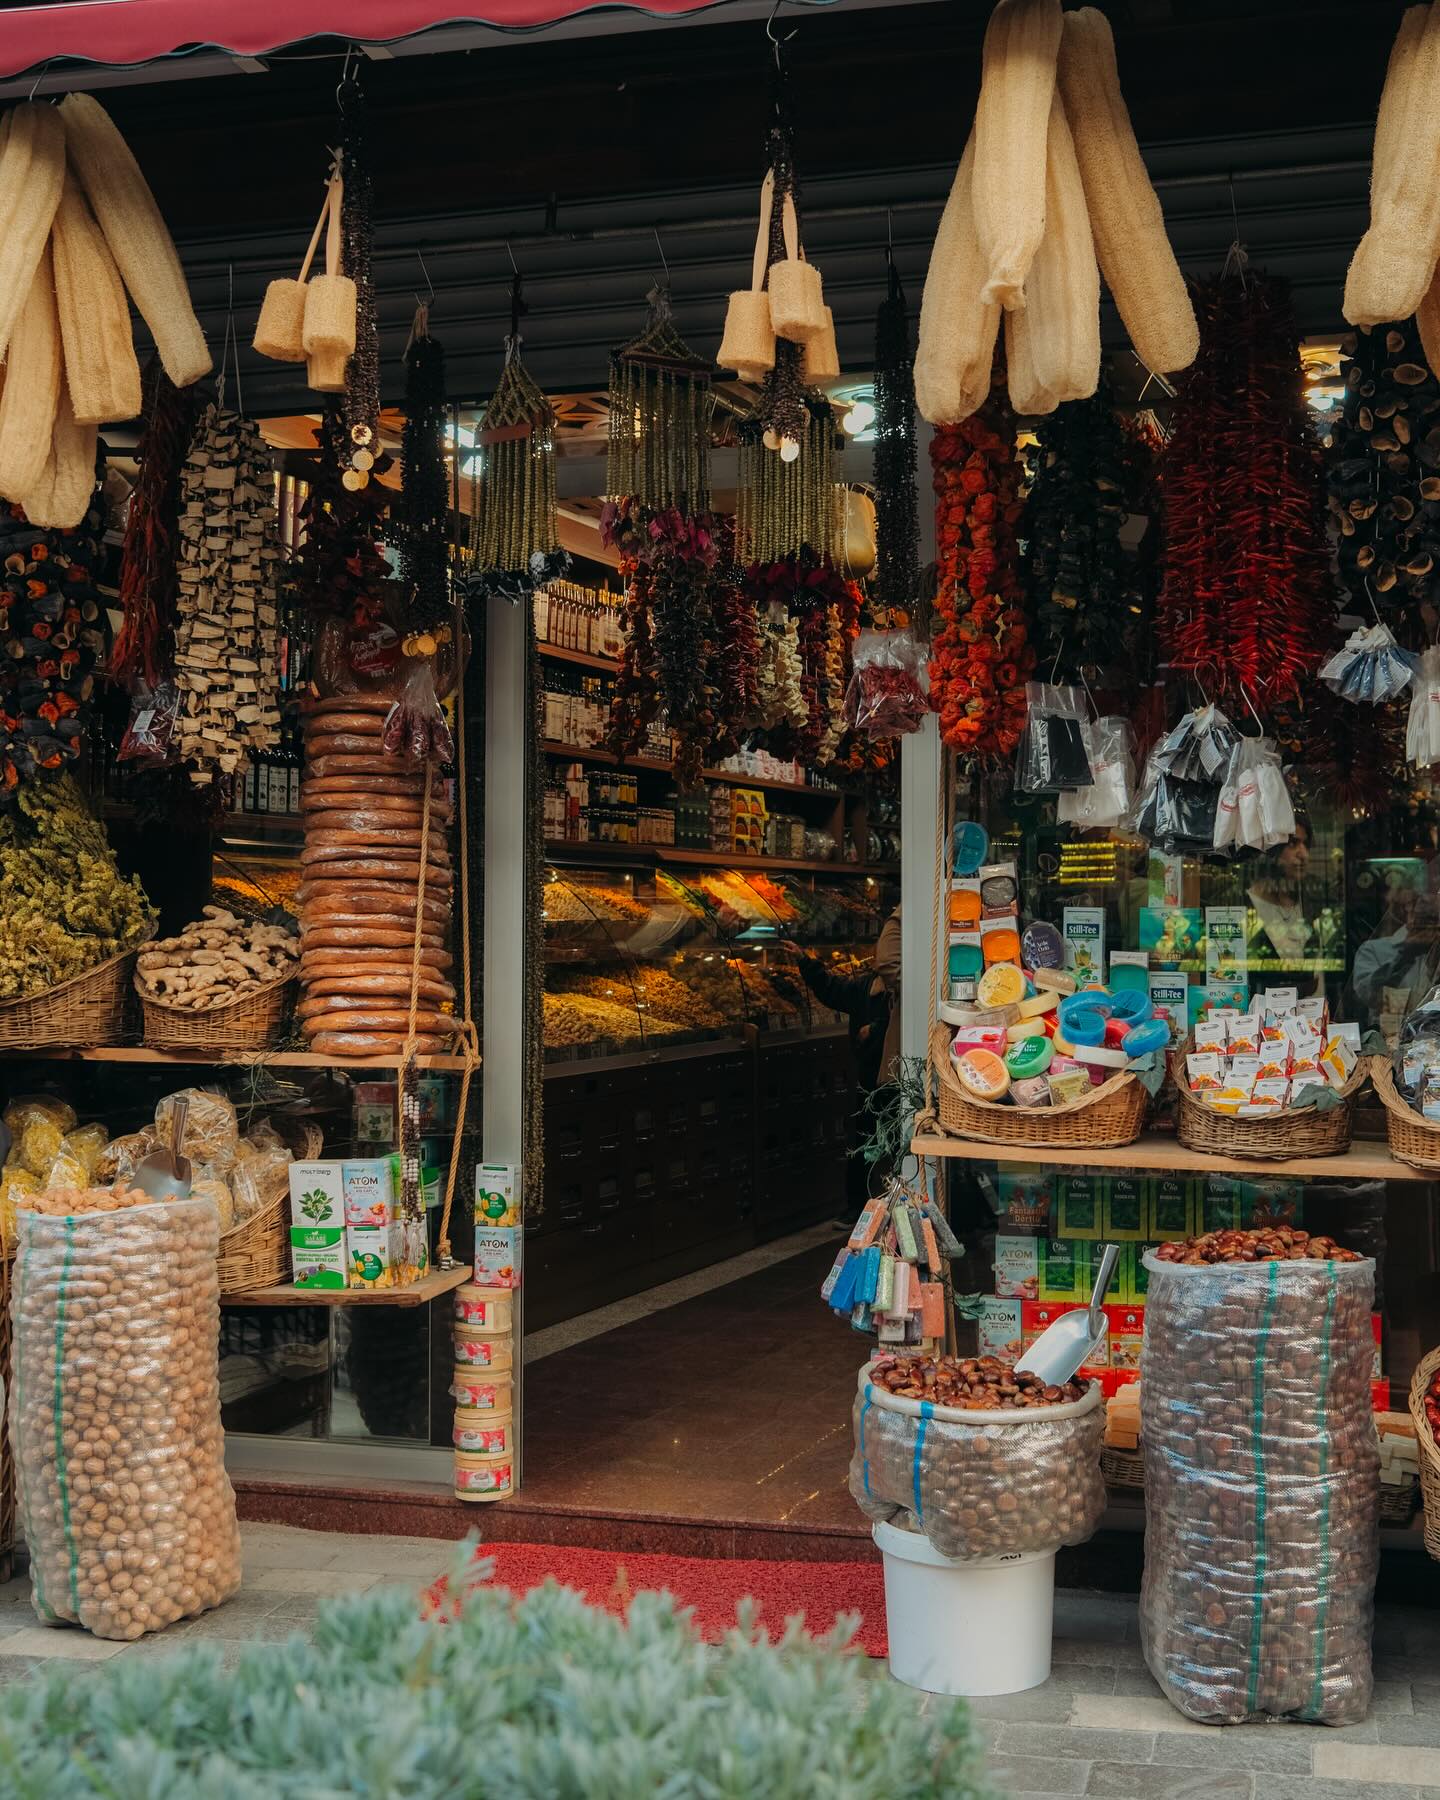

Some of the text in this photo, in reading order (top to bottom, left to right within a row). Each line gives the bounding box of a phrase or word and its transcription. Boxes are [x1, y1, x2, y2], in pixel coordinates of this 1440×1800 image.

[1068, 925, 1098, 934] Still-Tee
[1152, 989, 1182, 998] Still-Tee
[348, 1176, 379, 1186] ATOM
[480, 1239, 509, 1249] ATOM
[1000, 1248, 1033, 1259] ATOM
[984, 1311, 1016, 1322] ATOM
